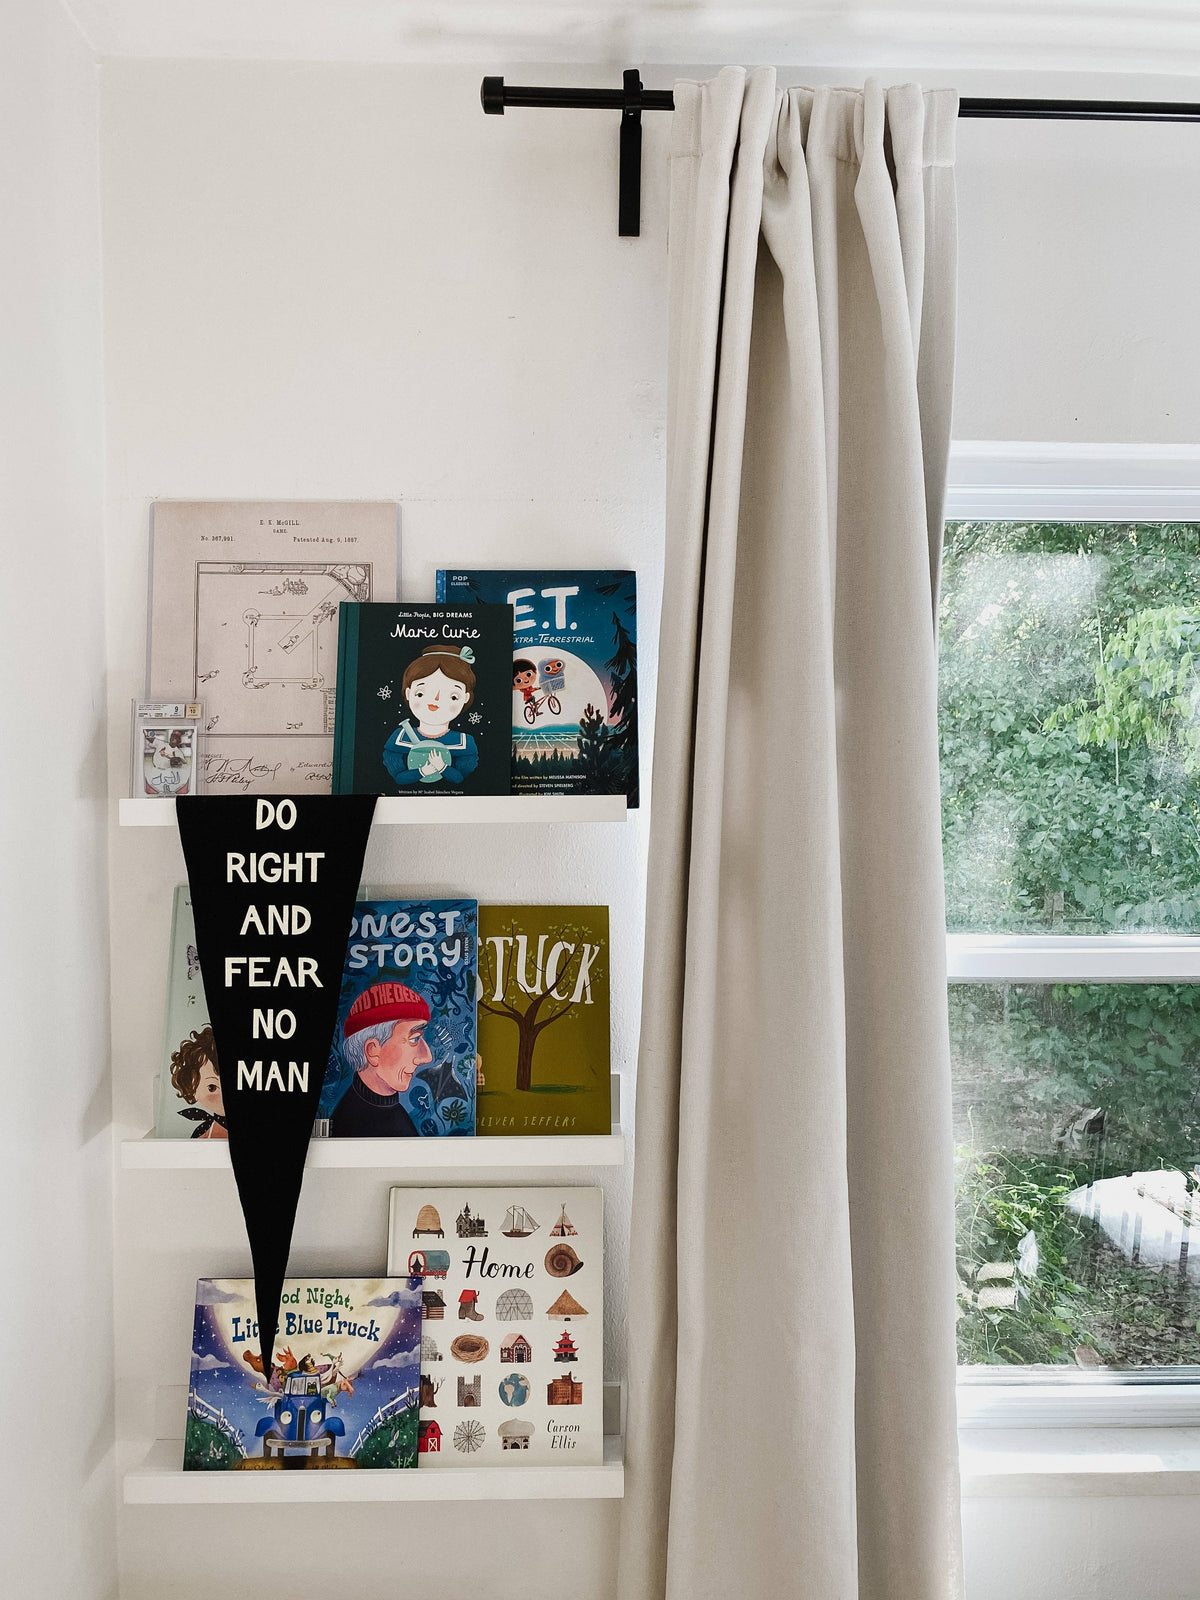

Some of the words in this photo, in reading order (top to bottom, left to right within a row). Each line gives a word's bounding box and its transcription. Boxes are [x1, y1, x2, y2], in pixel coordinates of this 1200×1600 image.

[507, 586, 580, 631] E.T.
[390, 623, 439, 638] Marie
[442, 624, 481, 639] Curie
[513, 633, 595, 644] XTRA-TERRESTRIAL
[255, 798, 297, 830] DO
[226, 852, 325, 883] RIGHT
[239, 904, 312, 935] AND
[348, 938, 461, 969] STORY
[224, 956, 324, 988] FEAR
[371, 983, 394, 1007] THE
[252, 1008, 297, 1039] NO
[237, 1060, 309, 1092] MAN
[476, 1116, 515, 1127] LIVER
[523, 1116, 576, 1127] JEFFERS
[462, 1245, 534, 1279] Home
[281, 1287, 300, 1304] od
[306, 1287, 354, 1311] Night,
[285, 1312, 323, 1335] Blue
[326, 1311, 380, 1342] Truck
[547, 1418, 580, 1433] Carson
[550, 1435, 577, 1449] Ellis
